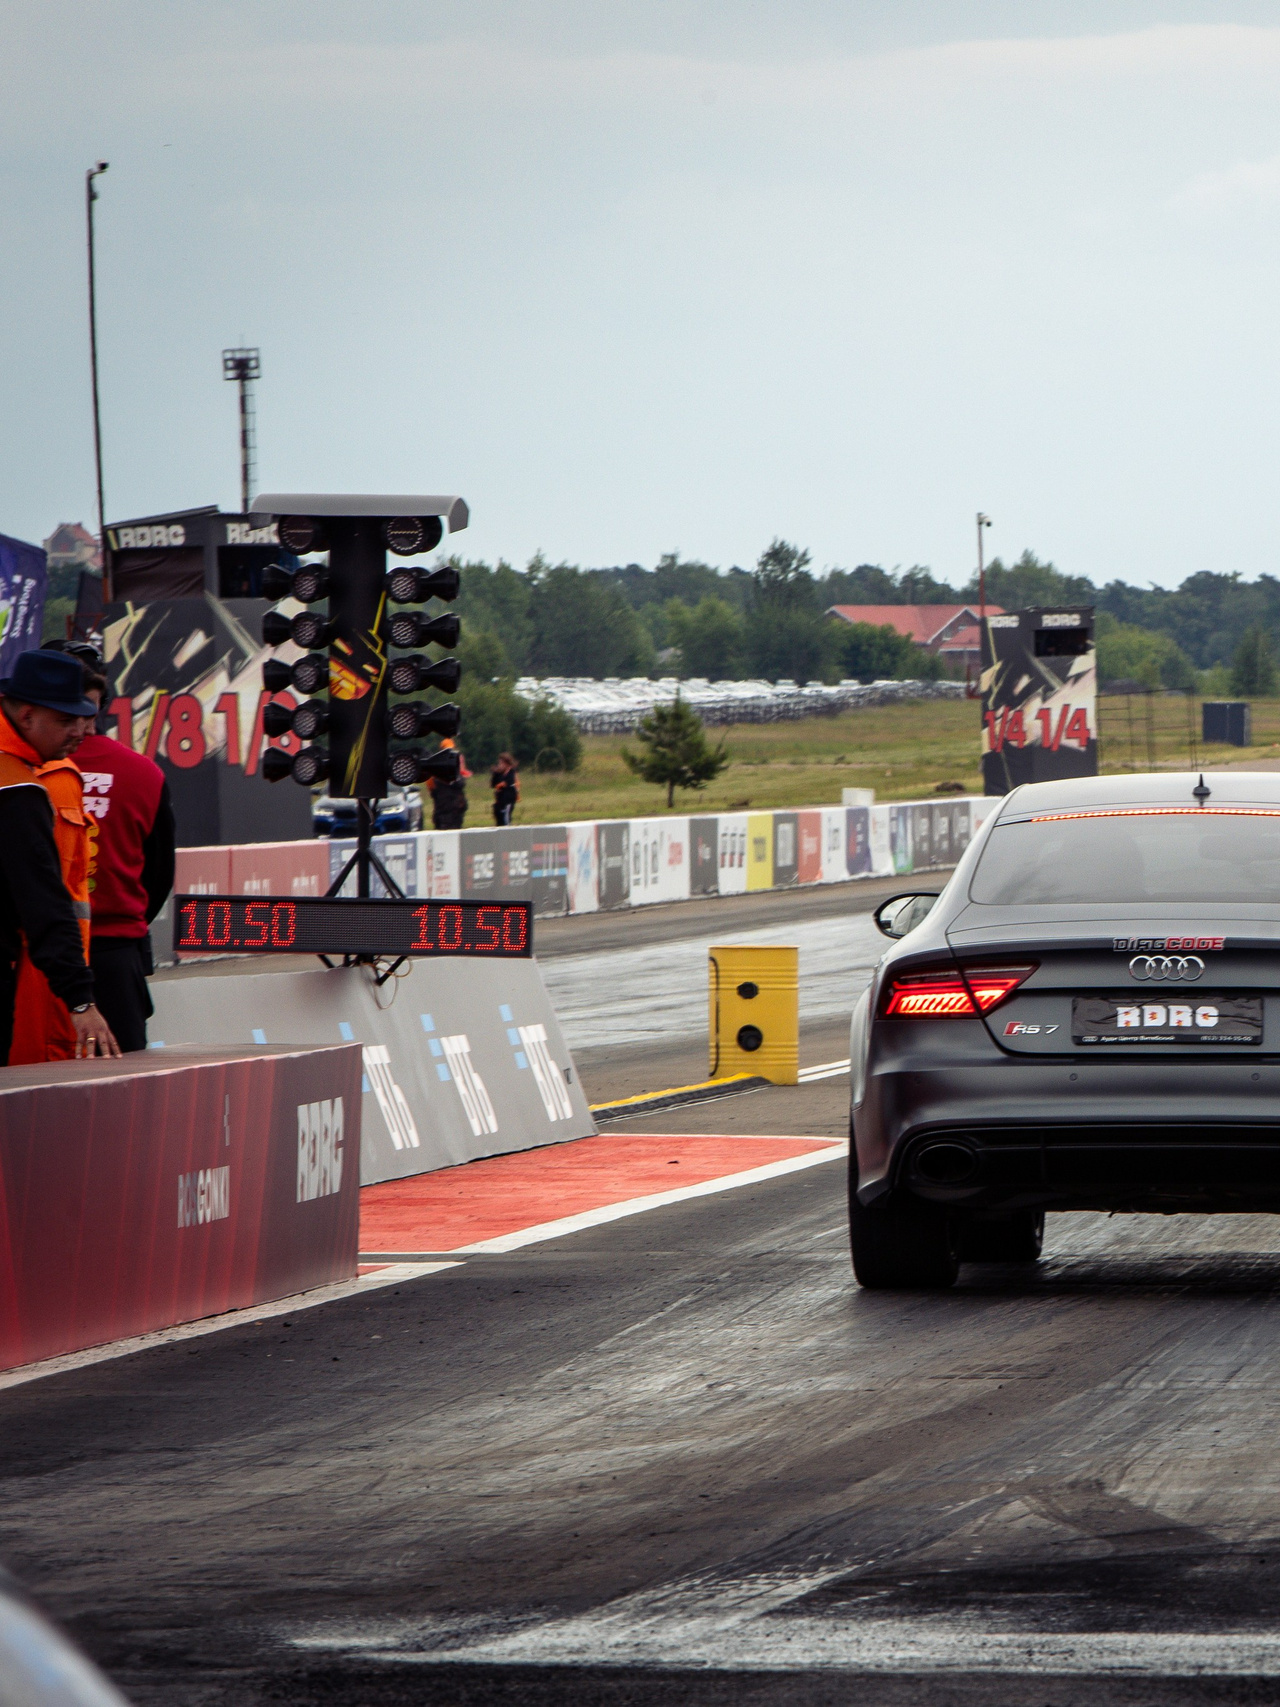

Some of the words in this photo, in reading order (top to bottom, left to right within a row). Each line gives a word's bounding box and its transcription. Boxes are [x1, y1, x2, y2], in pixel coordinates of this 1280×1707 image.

[108, 693, 206, 769] 1/8
[985, 706, 1026, 753] 1/4
[1035, 704, 1090, 752] 1/4
[179, 900, 297, 947] 10.50
[410, 904, 528, 951] 10.50
[1003, 1021, 1042, 1036] RS
[1045, 1024, 1060, 1035] 7
[1116, 1005, 1219, 1028] RDRC
[296, 1096, 344, 1203] RDRC
